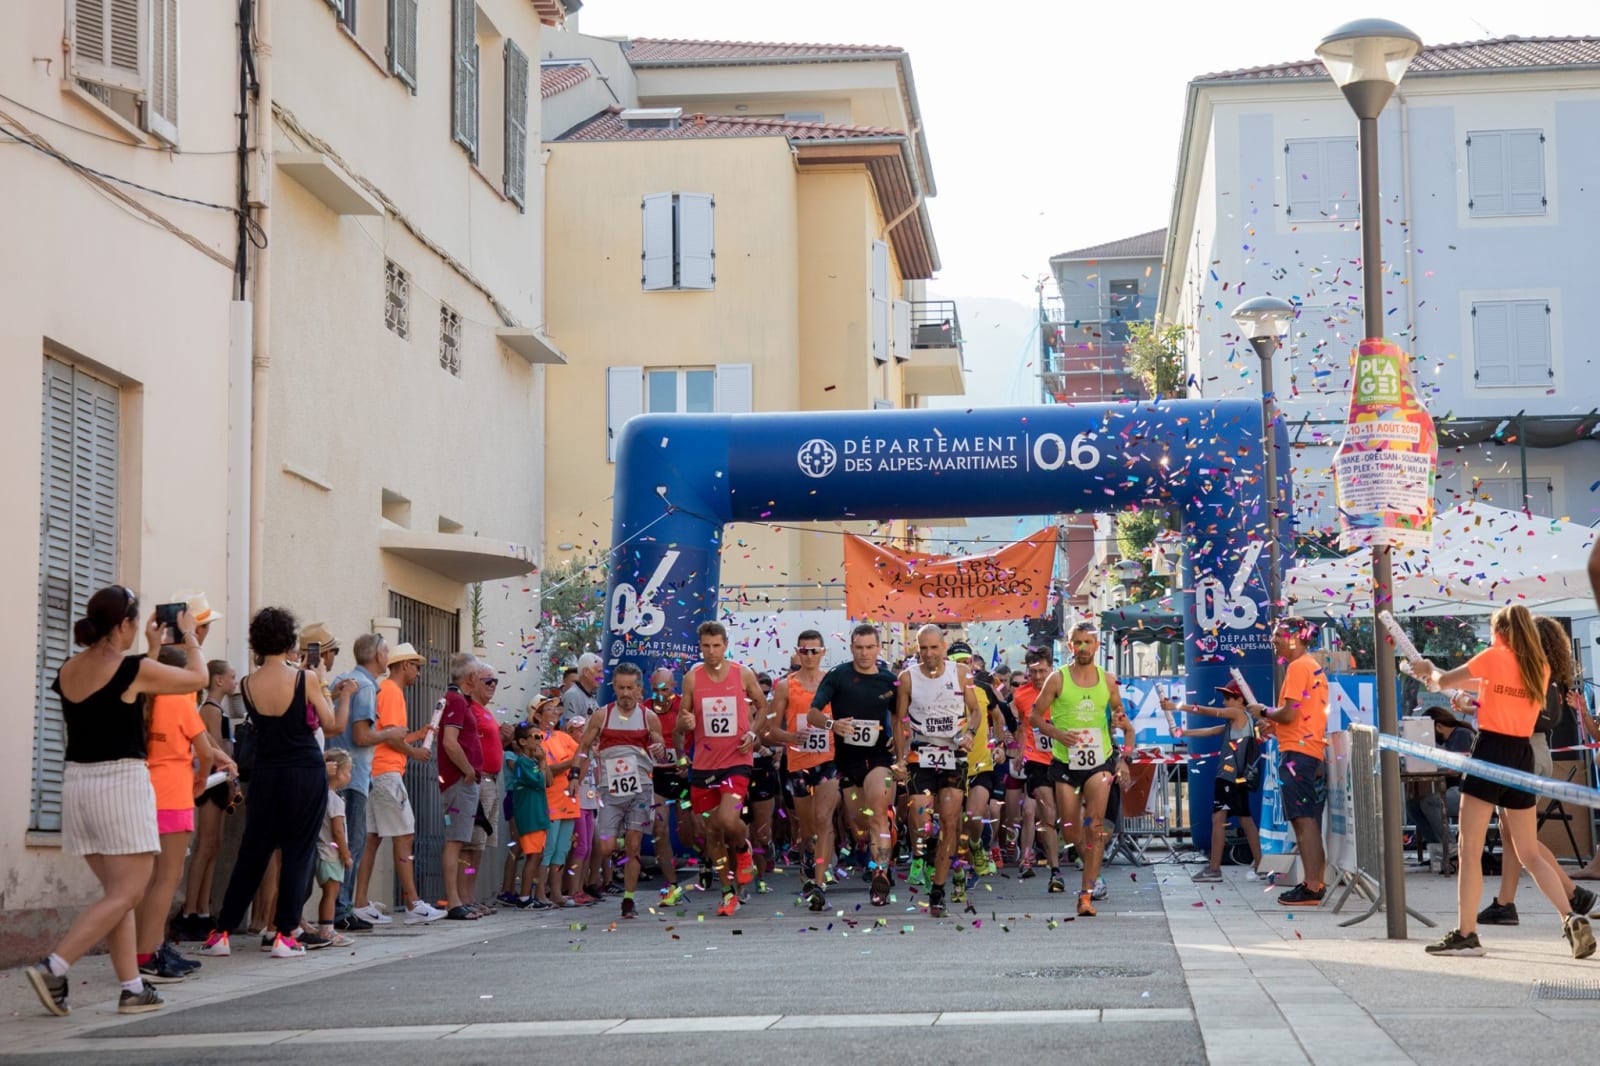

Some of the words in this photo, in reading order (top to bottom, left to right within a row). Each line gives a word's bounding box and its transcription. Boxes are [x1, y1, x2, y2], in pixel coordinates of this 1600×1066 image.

[1401, 425, 1419, 434] 2019
[844, 436, 1017, 454] DÉPARTEMENT
[1033, 433, 1100, 471] 06
[845, 458, 872, 472] DES
[878, 455, 1018, 471] ALPES-MARITIMES
[610, 550, 680, 636] 06
[1196, 541, 1264, 630] 06
[711, 718, 730, 734] 62
[852, 727, 871, 743] 56
[927, 753, 947, 767] 34
[1078, 750, 1096, 766] 38
[612, 776, 638, 794] 162
